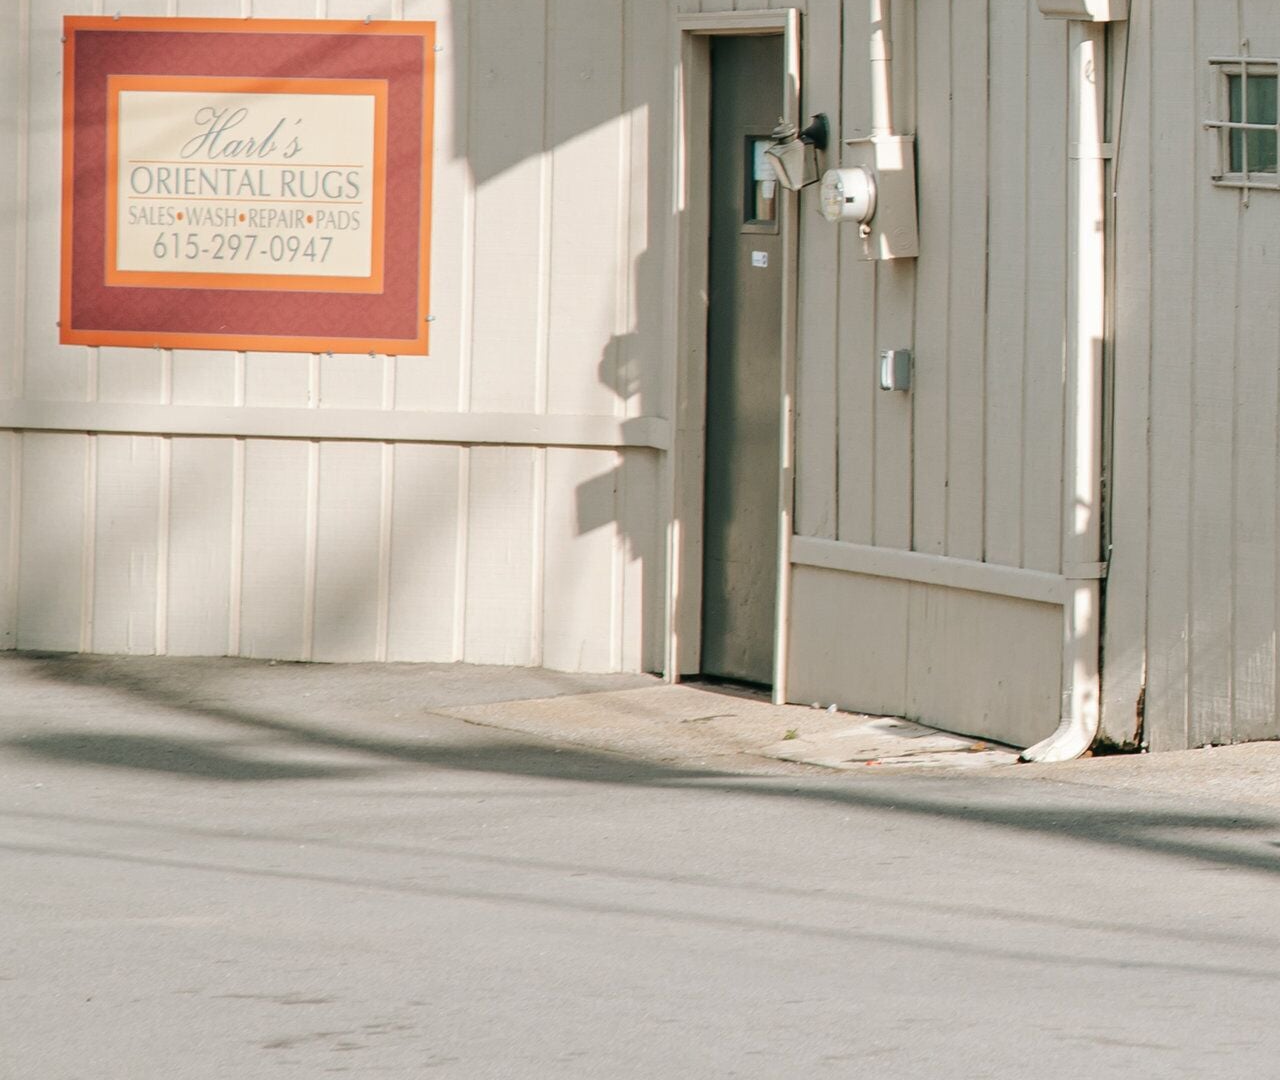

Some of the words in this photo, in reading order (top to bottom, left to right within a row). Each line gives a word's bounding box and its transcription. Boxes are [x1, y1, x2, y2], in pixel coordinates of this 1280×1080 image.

[180, 106, 303, 161] Harb's
[130, 165, 271, 197] ORIENTAL
[280, 170, 360, 200] RUGS
[128, 205, 176, 226] SALES
[185, 207, 238, 228] WASH
[248, 209, 305, 230] REPAIR
[315, 210, 360, 231] PADS
[152, 232, 333, 263] 615-297-0947
